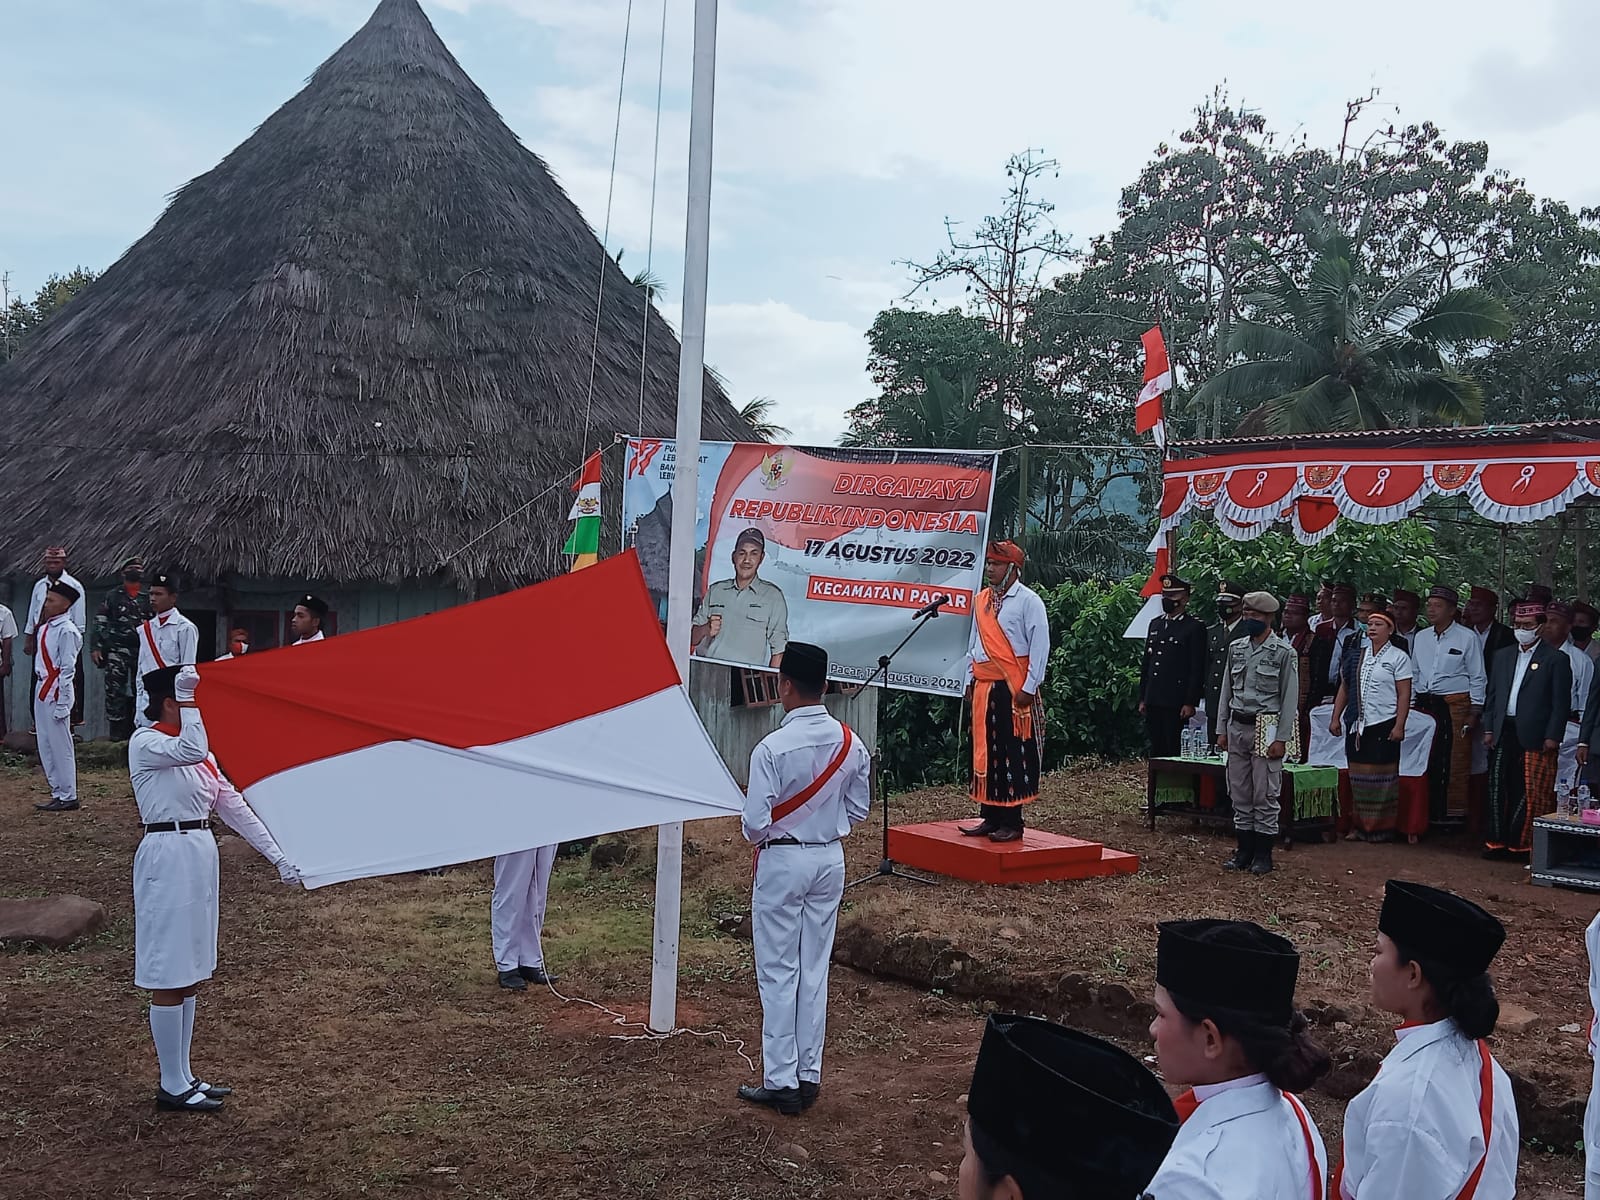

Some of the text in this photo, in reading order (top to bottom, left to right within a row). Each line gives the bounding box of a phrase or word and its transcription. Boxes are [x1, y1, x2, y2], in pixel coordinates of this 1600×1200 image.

[833, 473, 979, 500] DIRGAHAYU
[729, 499, 979, 535] REPUBLIK INDONESIA
[803, 539, 977, 571] 17 AGUSTUS 2022
[812, 580, 905, 602] KECAMATAN
[830, 663, 864, 679] Pacar,
[930, 676, 961, 691] 2022
